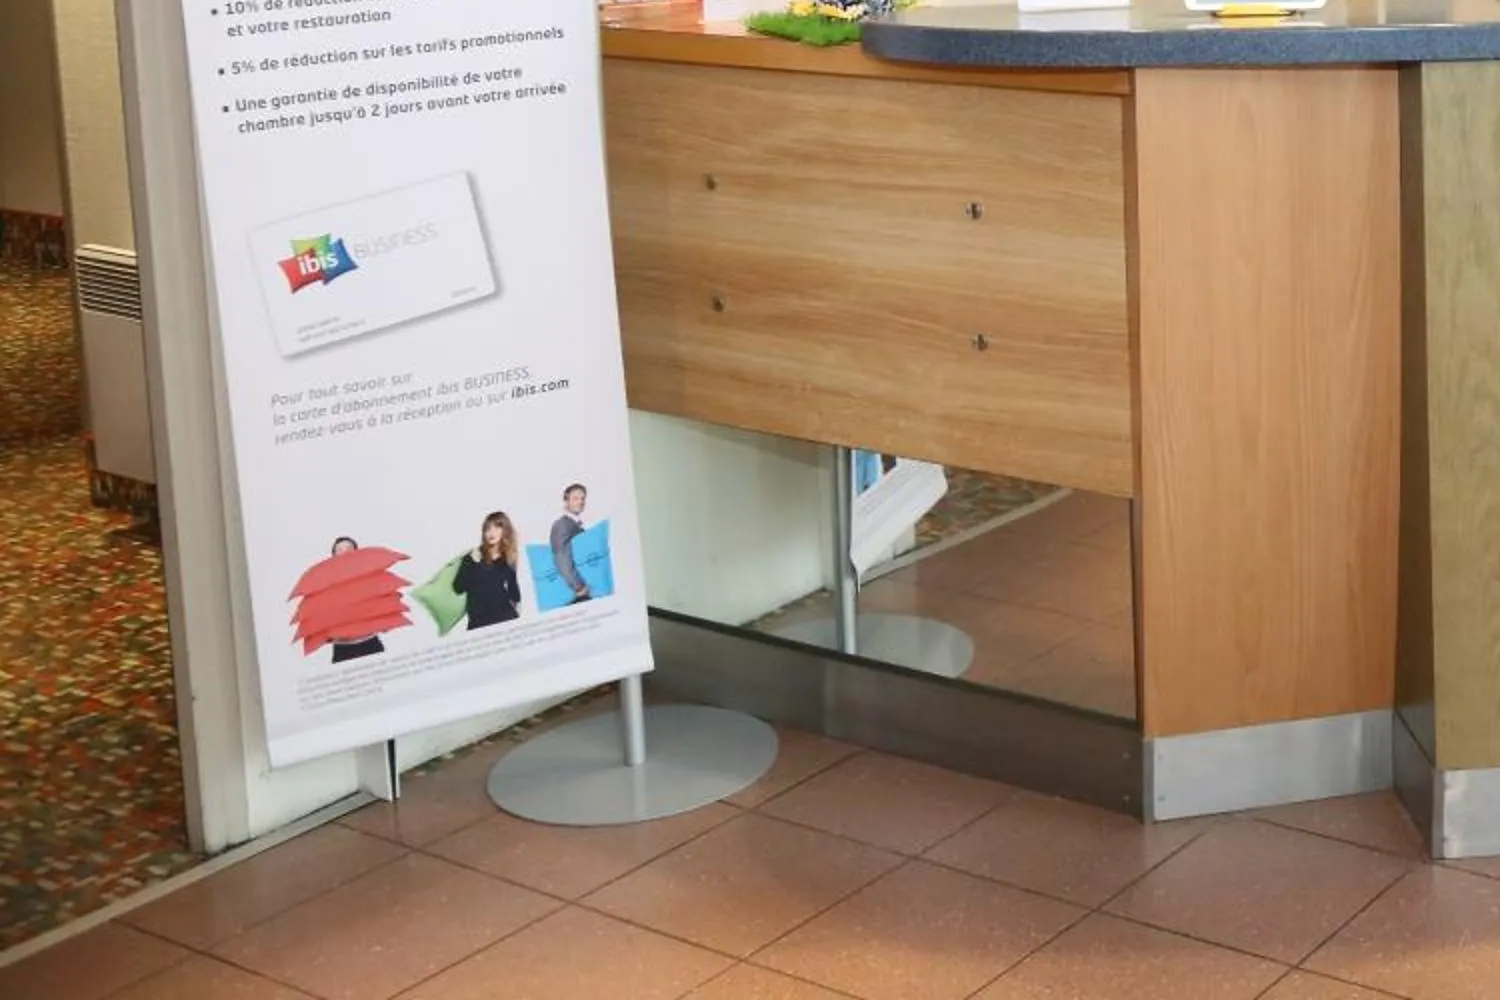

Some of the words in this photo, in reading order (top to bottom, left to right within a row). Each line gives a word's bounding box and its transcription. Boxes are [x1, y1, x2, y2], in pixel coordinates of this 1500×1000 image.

[224, 0, 260, 17] 10%
[227, 24, 243, 38] et
[247, 19, 289, 35] votre
[294, 10, 391, 30] restauration
[231, 61, 256, 75] 5%
[259, 57, 279, 71] de
[284, 50, 358, 69] réduction
[363, 48, 385, 61] sur
[390, 42, 413, 58] les
[416, 37, 457, 54] tarifs
[461, 27, 564, 51] promotionnels
[236, 95, 267, 113] Une
[271, 90, 338, 109] garantie
[342, 84, 362, 100] de
[366, 74, 459, 97] disponibilité
[463, 71, 482, 85] de
[485, 67, 522, 82] votre
[238, 114, 306, 134] chambre
[370, 103, 381, 117] 2
[385, 101, 424, 119] jours
[427, 94, 469, 110] avant
[473, 88, 511, 106] votre
[515, 81, 567, 99] arrivée
[299, 252, 340, 277] ibis
[352, 222, 439, 259] BUSINESS
[271, 390, 303, 408] Pour
[308, 385, 339, 401] tout
[343, 377, 387, 398] savoir
[390, 372, 412, 385] sur
[273, 411, 286, 427] la
[290, 405, 327, 424] carte
[437, 381, 459, 397] ibis
[367, 415, 378, 429] à
[381, 411, 394, 427] la
[398, 400, 461, 421] réception
[465, 395, 483, 409] ou
[487, 392, 507, 404] sur
[511, 377, 569, 399] ibis.com
